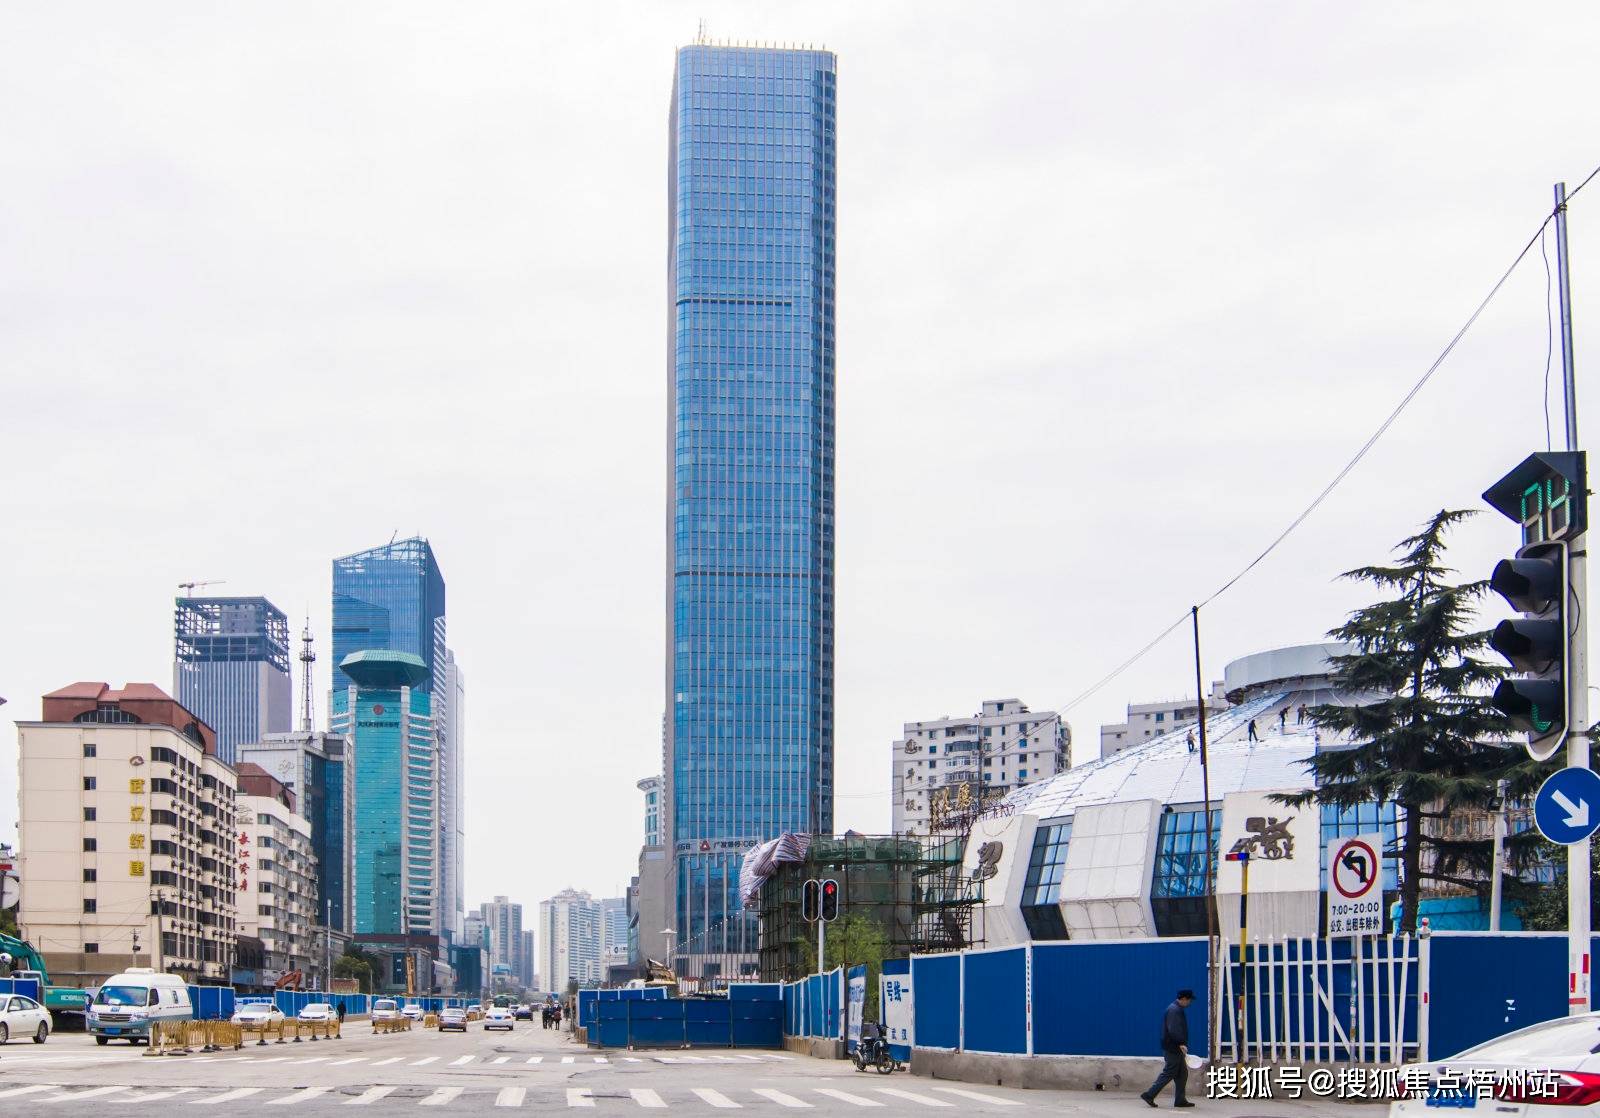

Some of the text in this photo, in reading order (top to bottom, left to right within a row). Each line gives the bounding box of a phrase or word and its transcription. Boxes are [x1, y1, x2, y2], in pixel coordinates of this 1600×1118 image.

[129, 779, 145, 877] 武汉统建
[1331, 917, 1379, 932] 公交、出租车除外
